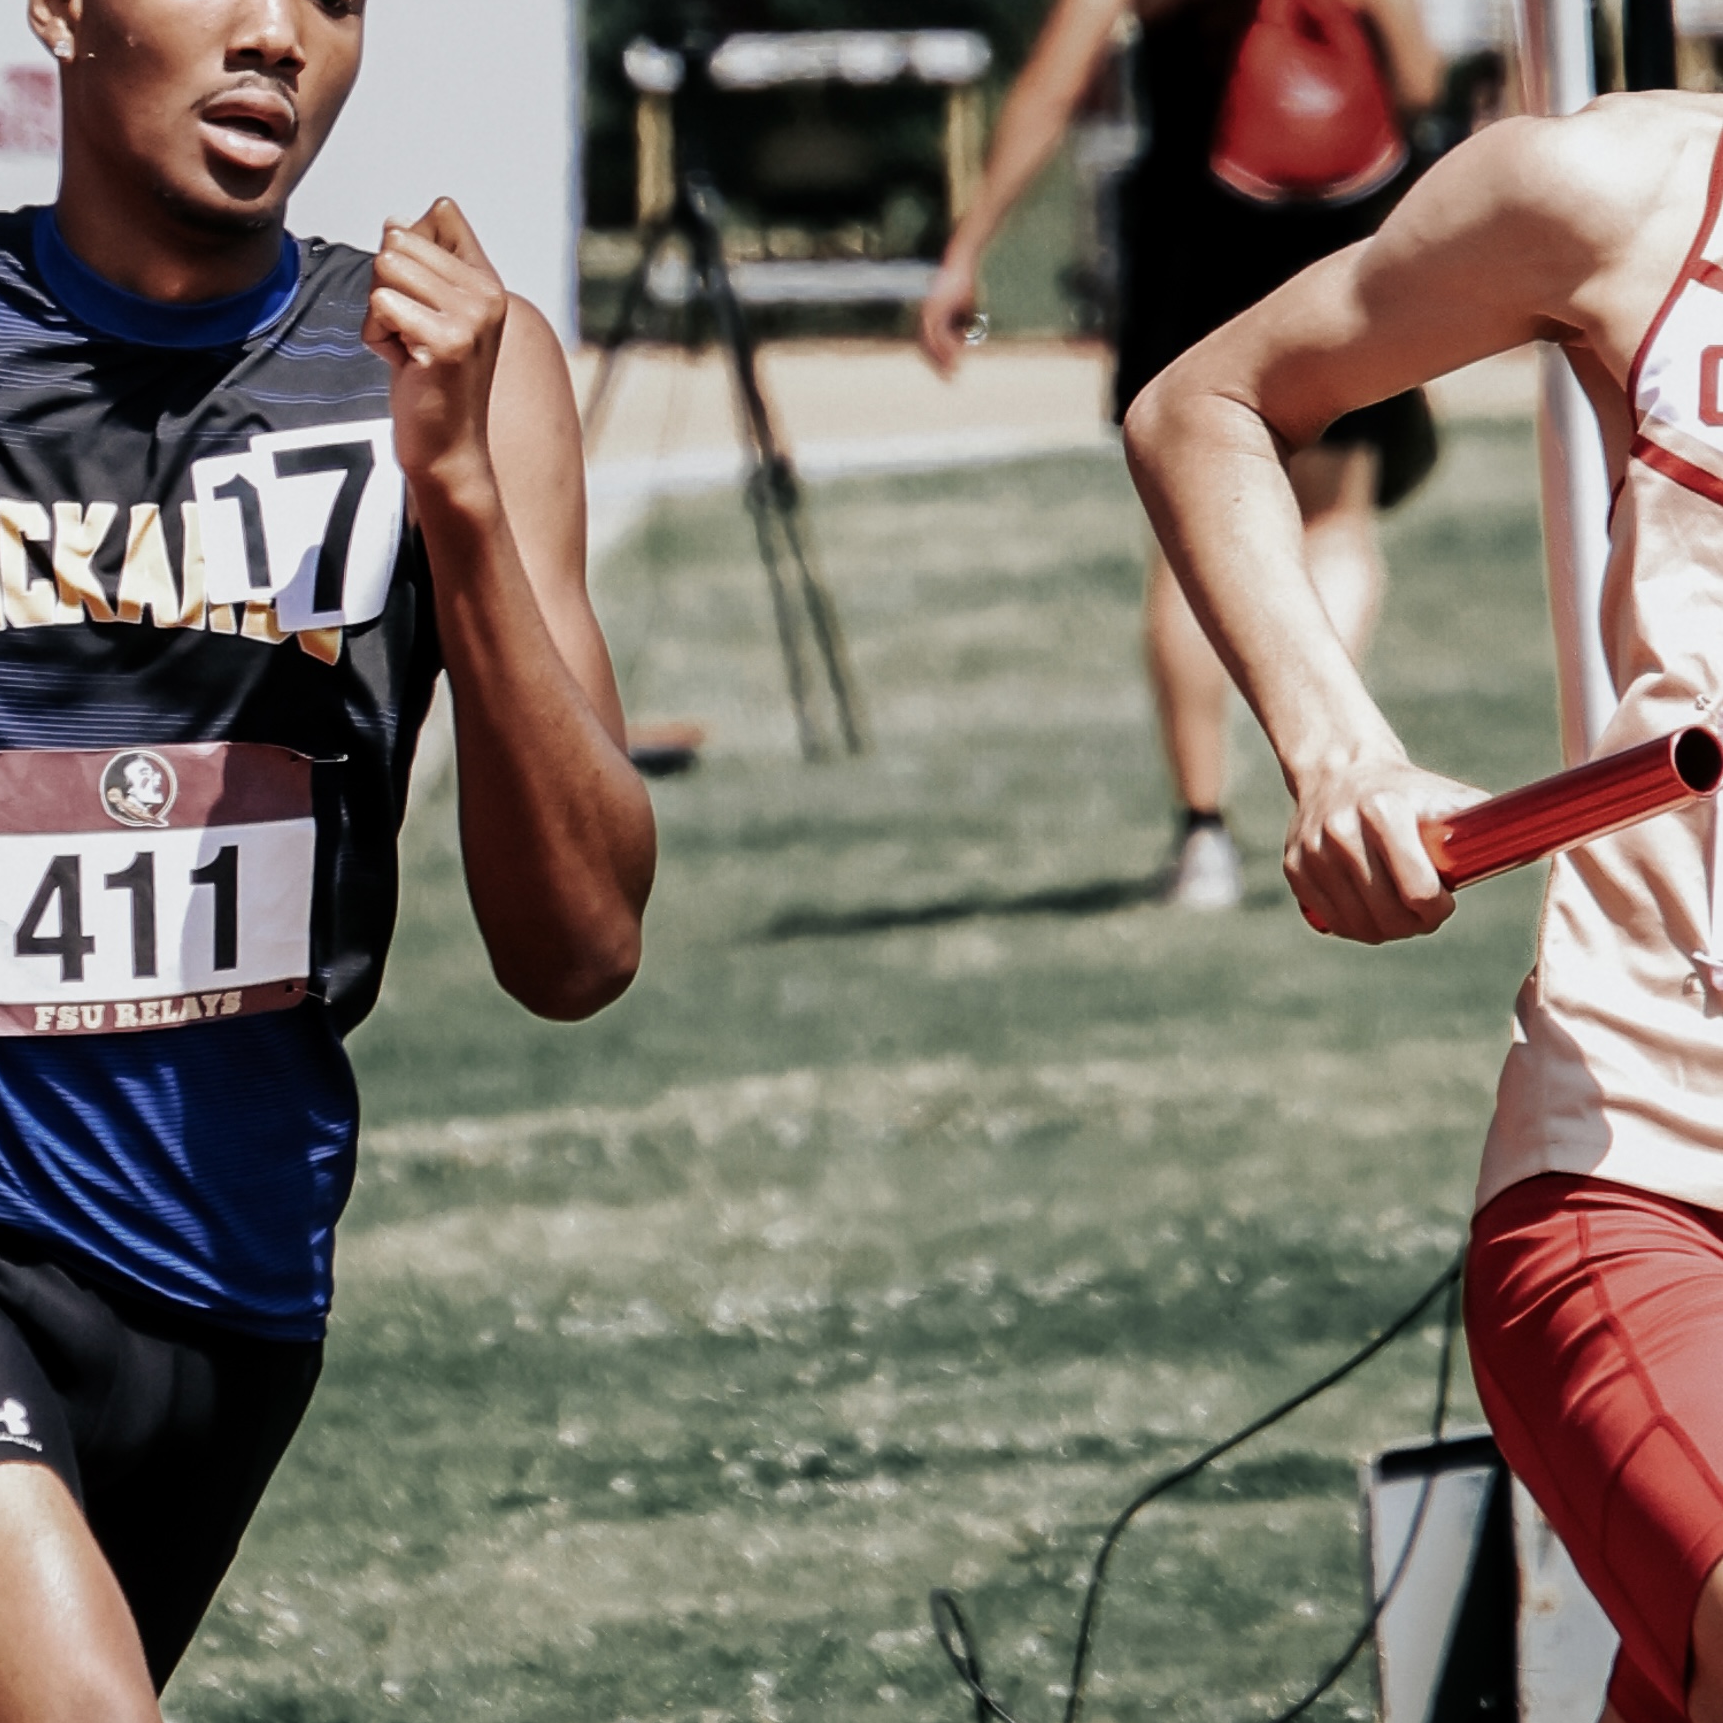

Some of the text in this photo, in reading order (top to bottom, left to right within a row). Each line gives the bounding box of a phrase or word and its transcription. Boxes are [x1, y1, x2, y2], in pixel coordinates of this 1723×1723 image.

[213, 439, 376, 614] 17
[15, 845, 241, 983] 411
[33, 990, 243, 1031] FSU RELAYS
